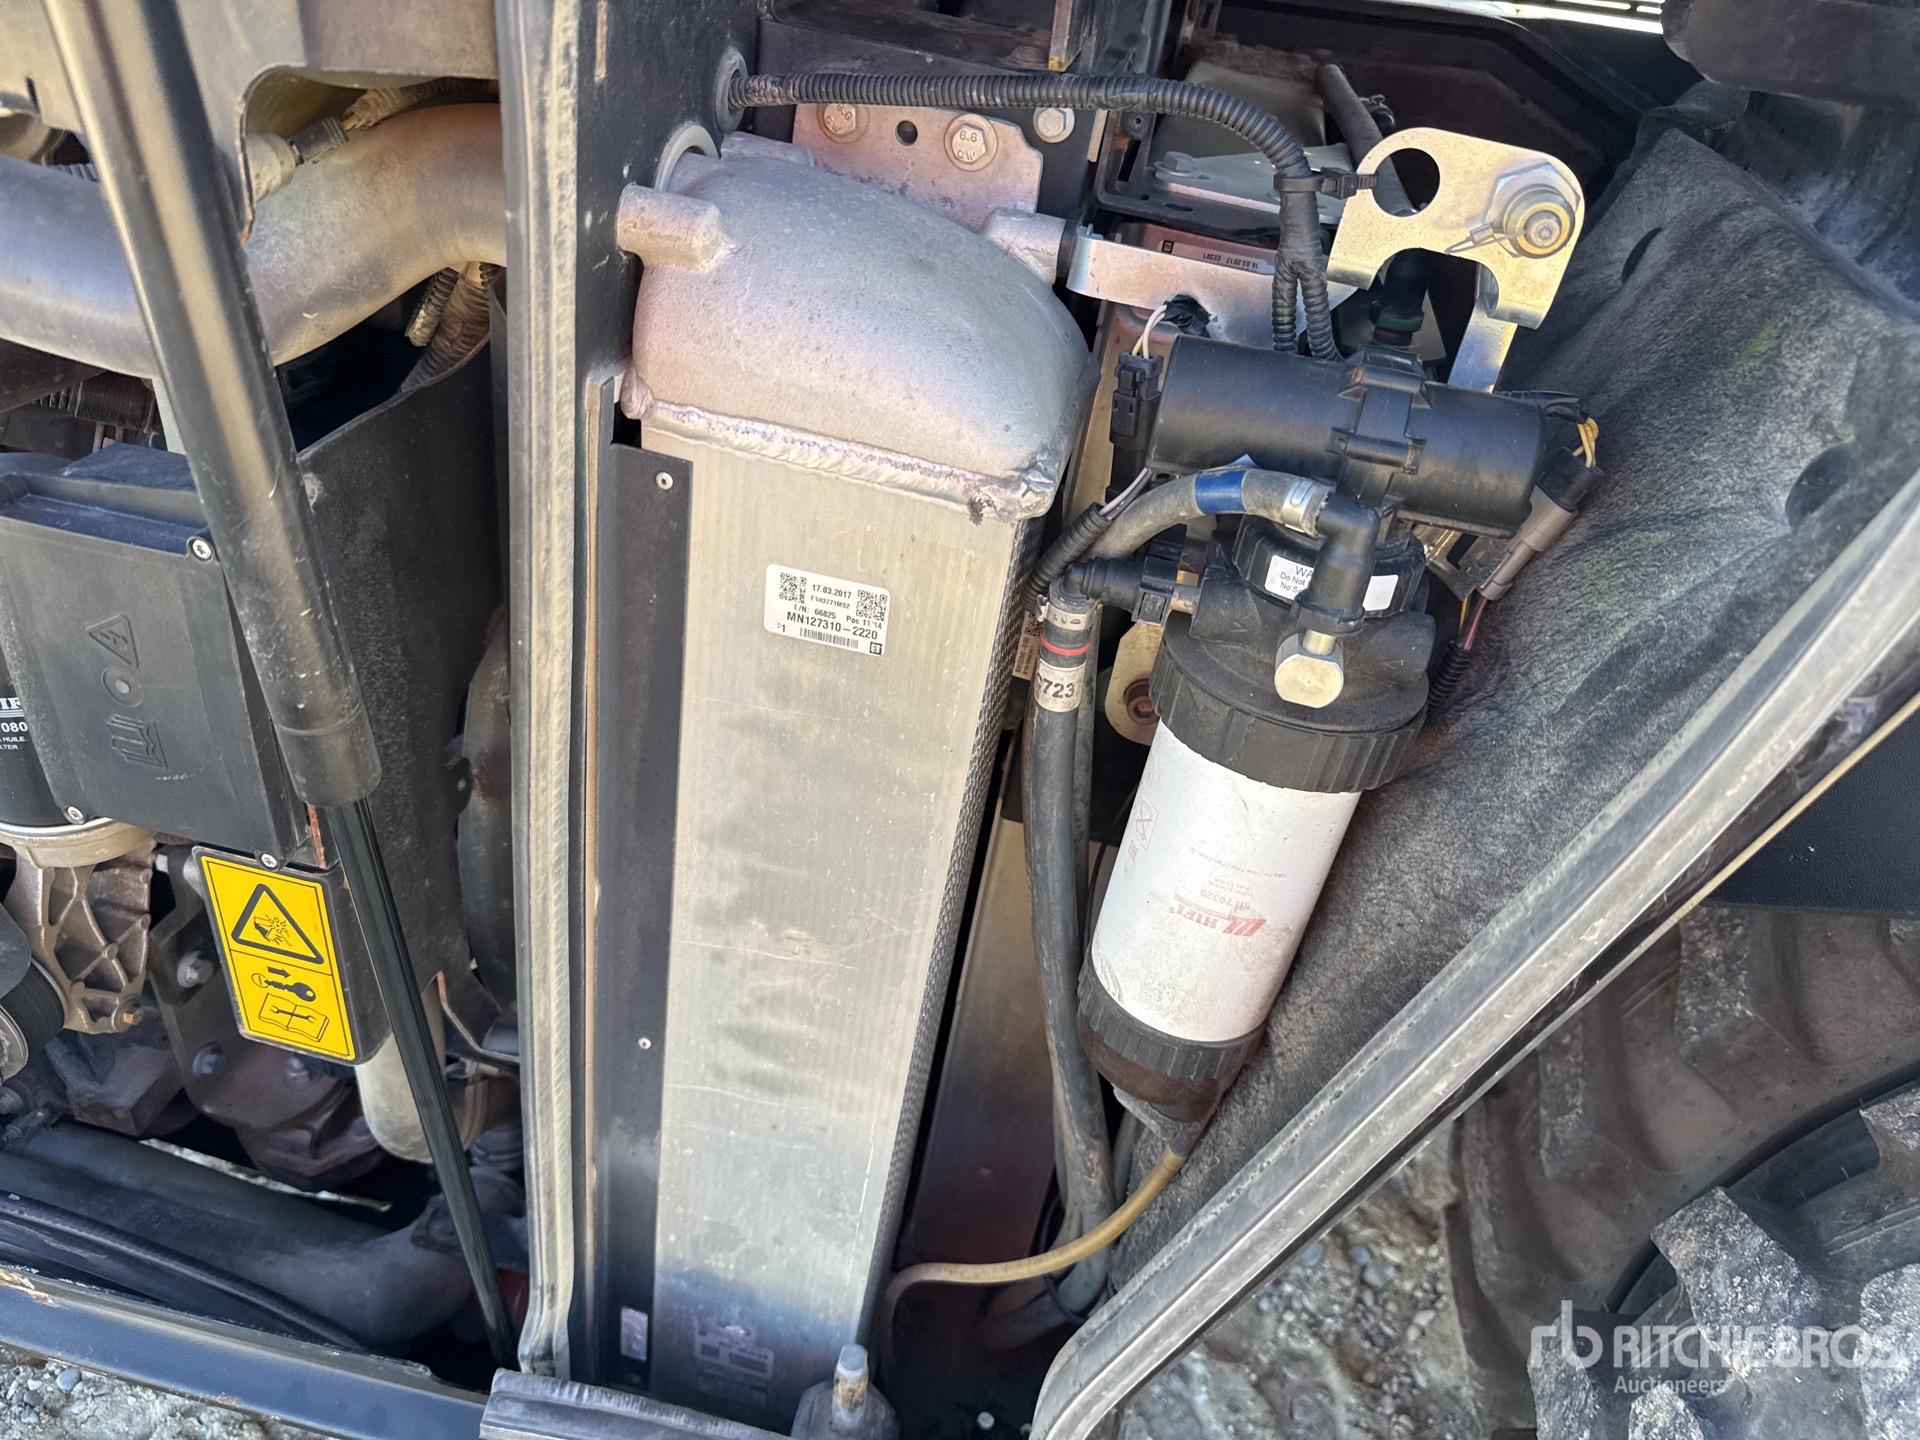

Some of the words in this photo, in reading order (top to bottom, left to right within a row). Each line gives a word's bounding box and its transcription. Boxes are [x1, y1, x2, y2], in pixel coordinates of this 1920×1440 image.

[1280, 571, 1291, 581] Do
[1291, 575, 1306, 587] Not
[1280, 581, 1291, 591] No
[812, 584, 852, 599] 17.03.2017
[814, 608, 837, 620] 66825
[846, 615, 860, 625] Pos
[1200, 889, 1232, 907] 70320
